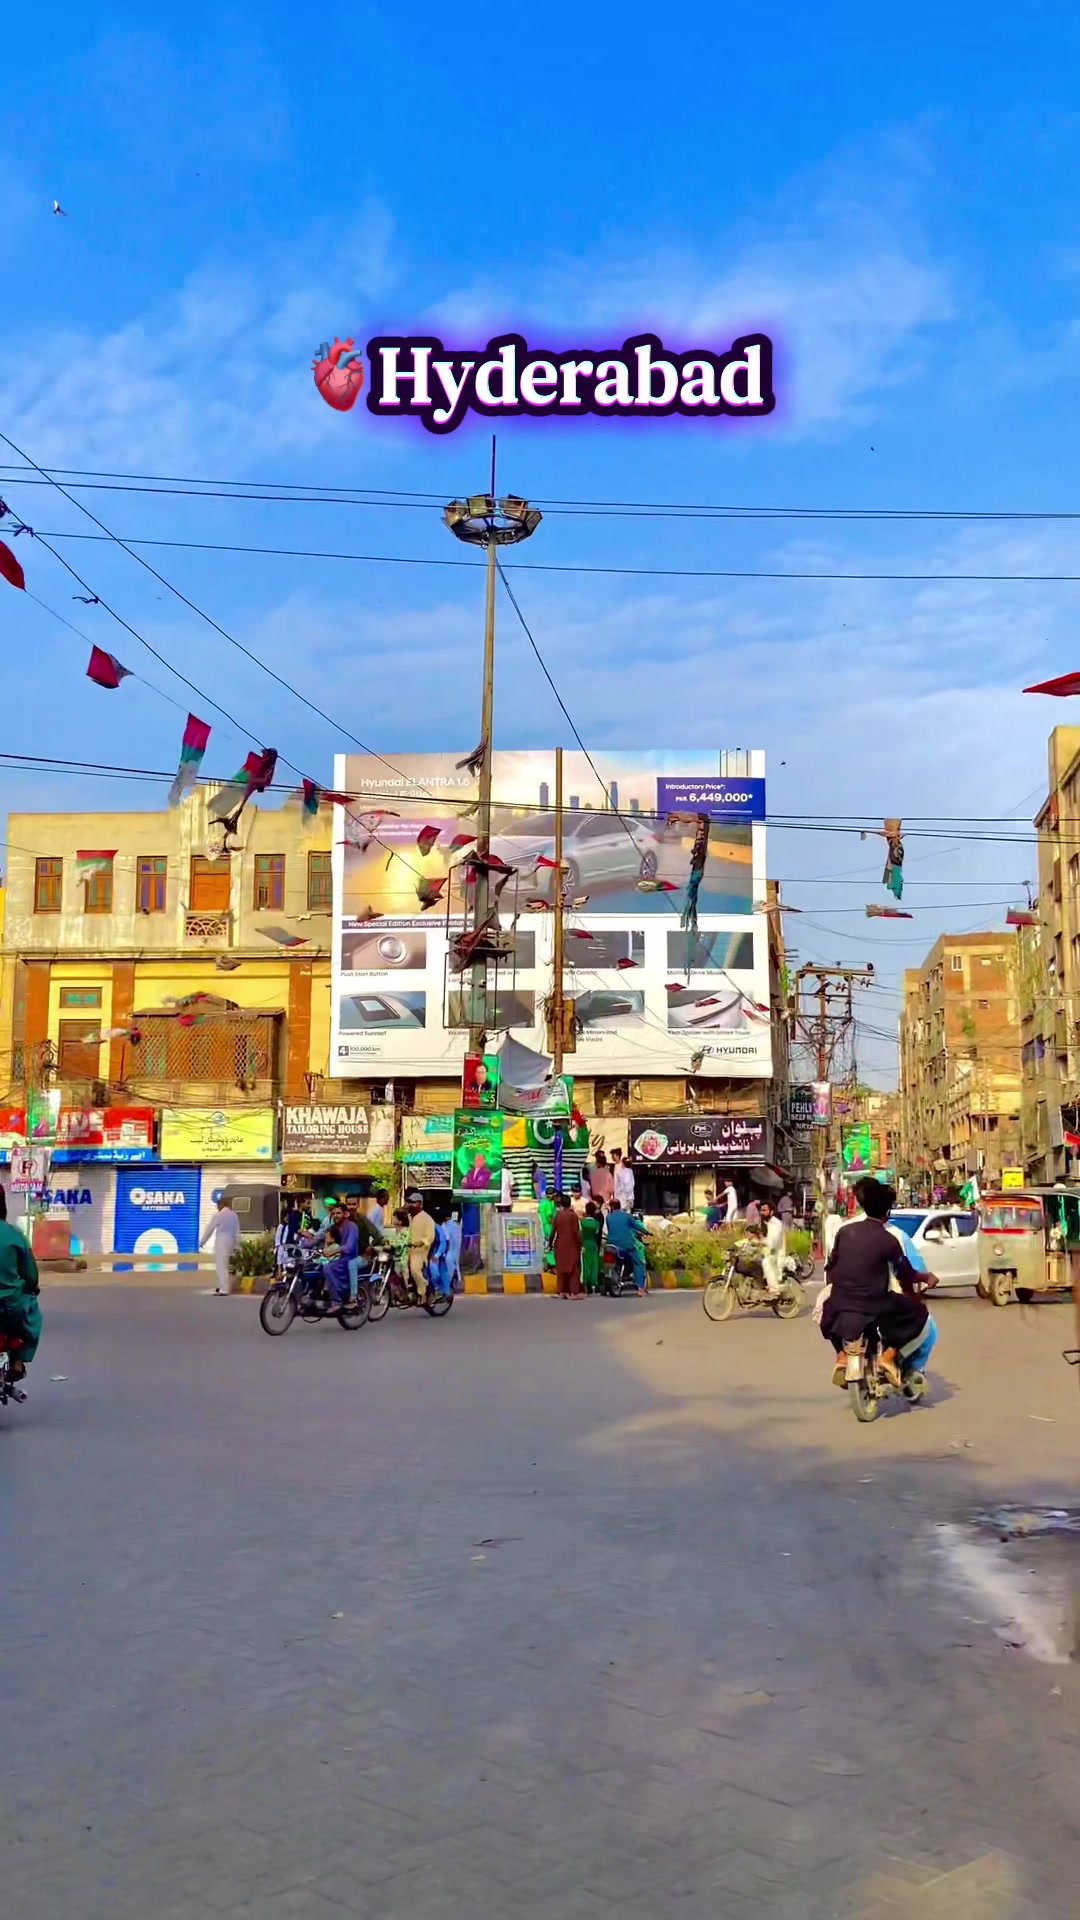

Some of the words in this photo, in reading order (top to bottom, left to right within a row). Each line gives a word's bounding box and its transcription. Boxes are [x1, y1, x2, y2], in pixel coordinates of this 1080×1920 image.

[360, 778, 403, 788] Hyundai
[405, 778, 455, 787] ELANTRA
[665, 783, 704, 791] Introductory
[286, 1107, 368, 1125] KHAWAJA
[286, 1124, 336, 1135] TAILORING
[338, 1124, 369, 1135] HOUSE
[721, 1121, 763, 1140] پہلوان
[34, 1188, 92, 1205] SAKA
[130, 1188, 185, 1206] OSAKA
